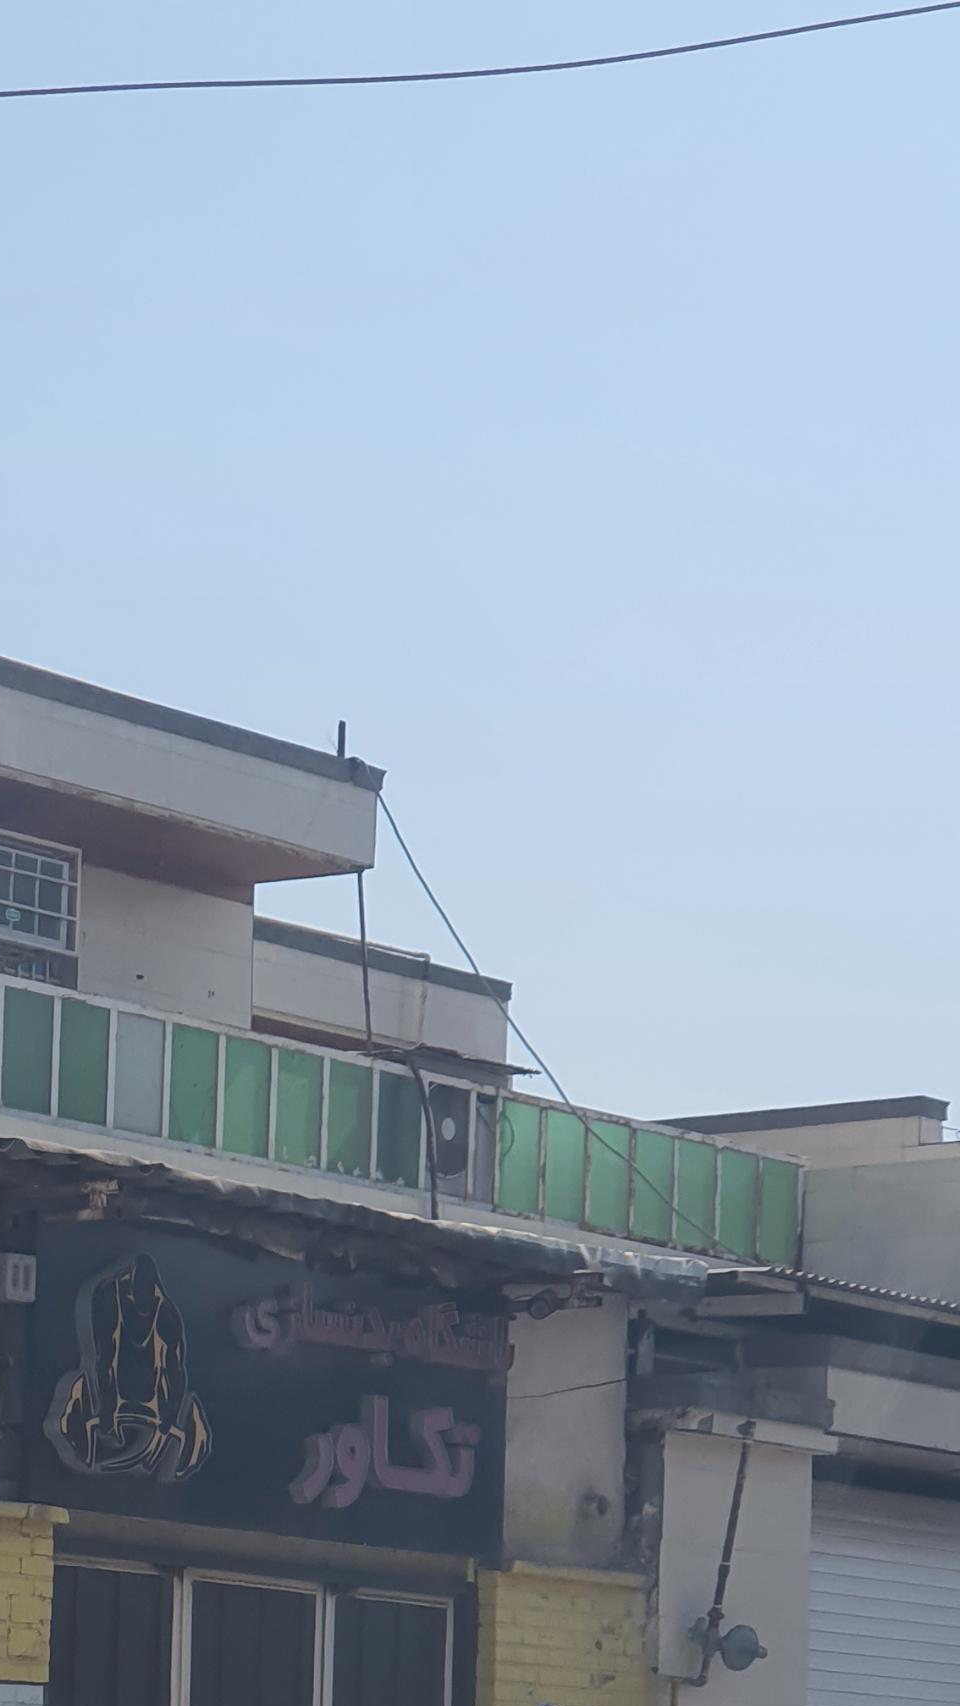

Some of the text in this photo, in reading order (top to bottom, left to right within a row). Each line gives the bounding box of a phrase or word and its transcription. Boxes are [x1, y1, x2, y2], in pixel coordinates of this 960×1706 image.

[234, 1282, 516, 1386] باشگاه بدنسازی
[290, 1394, 481, 1508] تکاور
